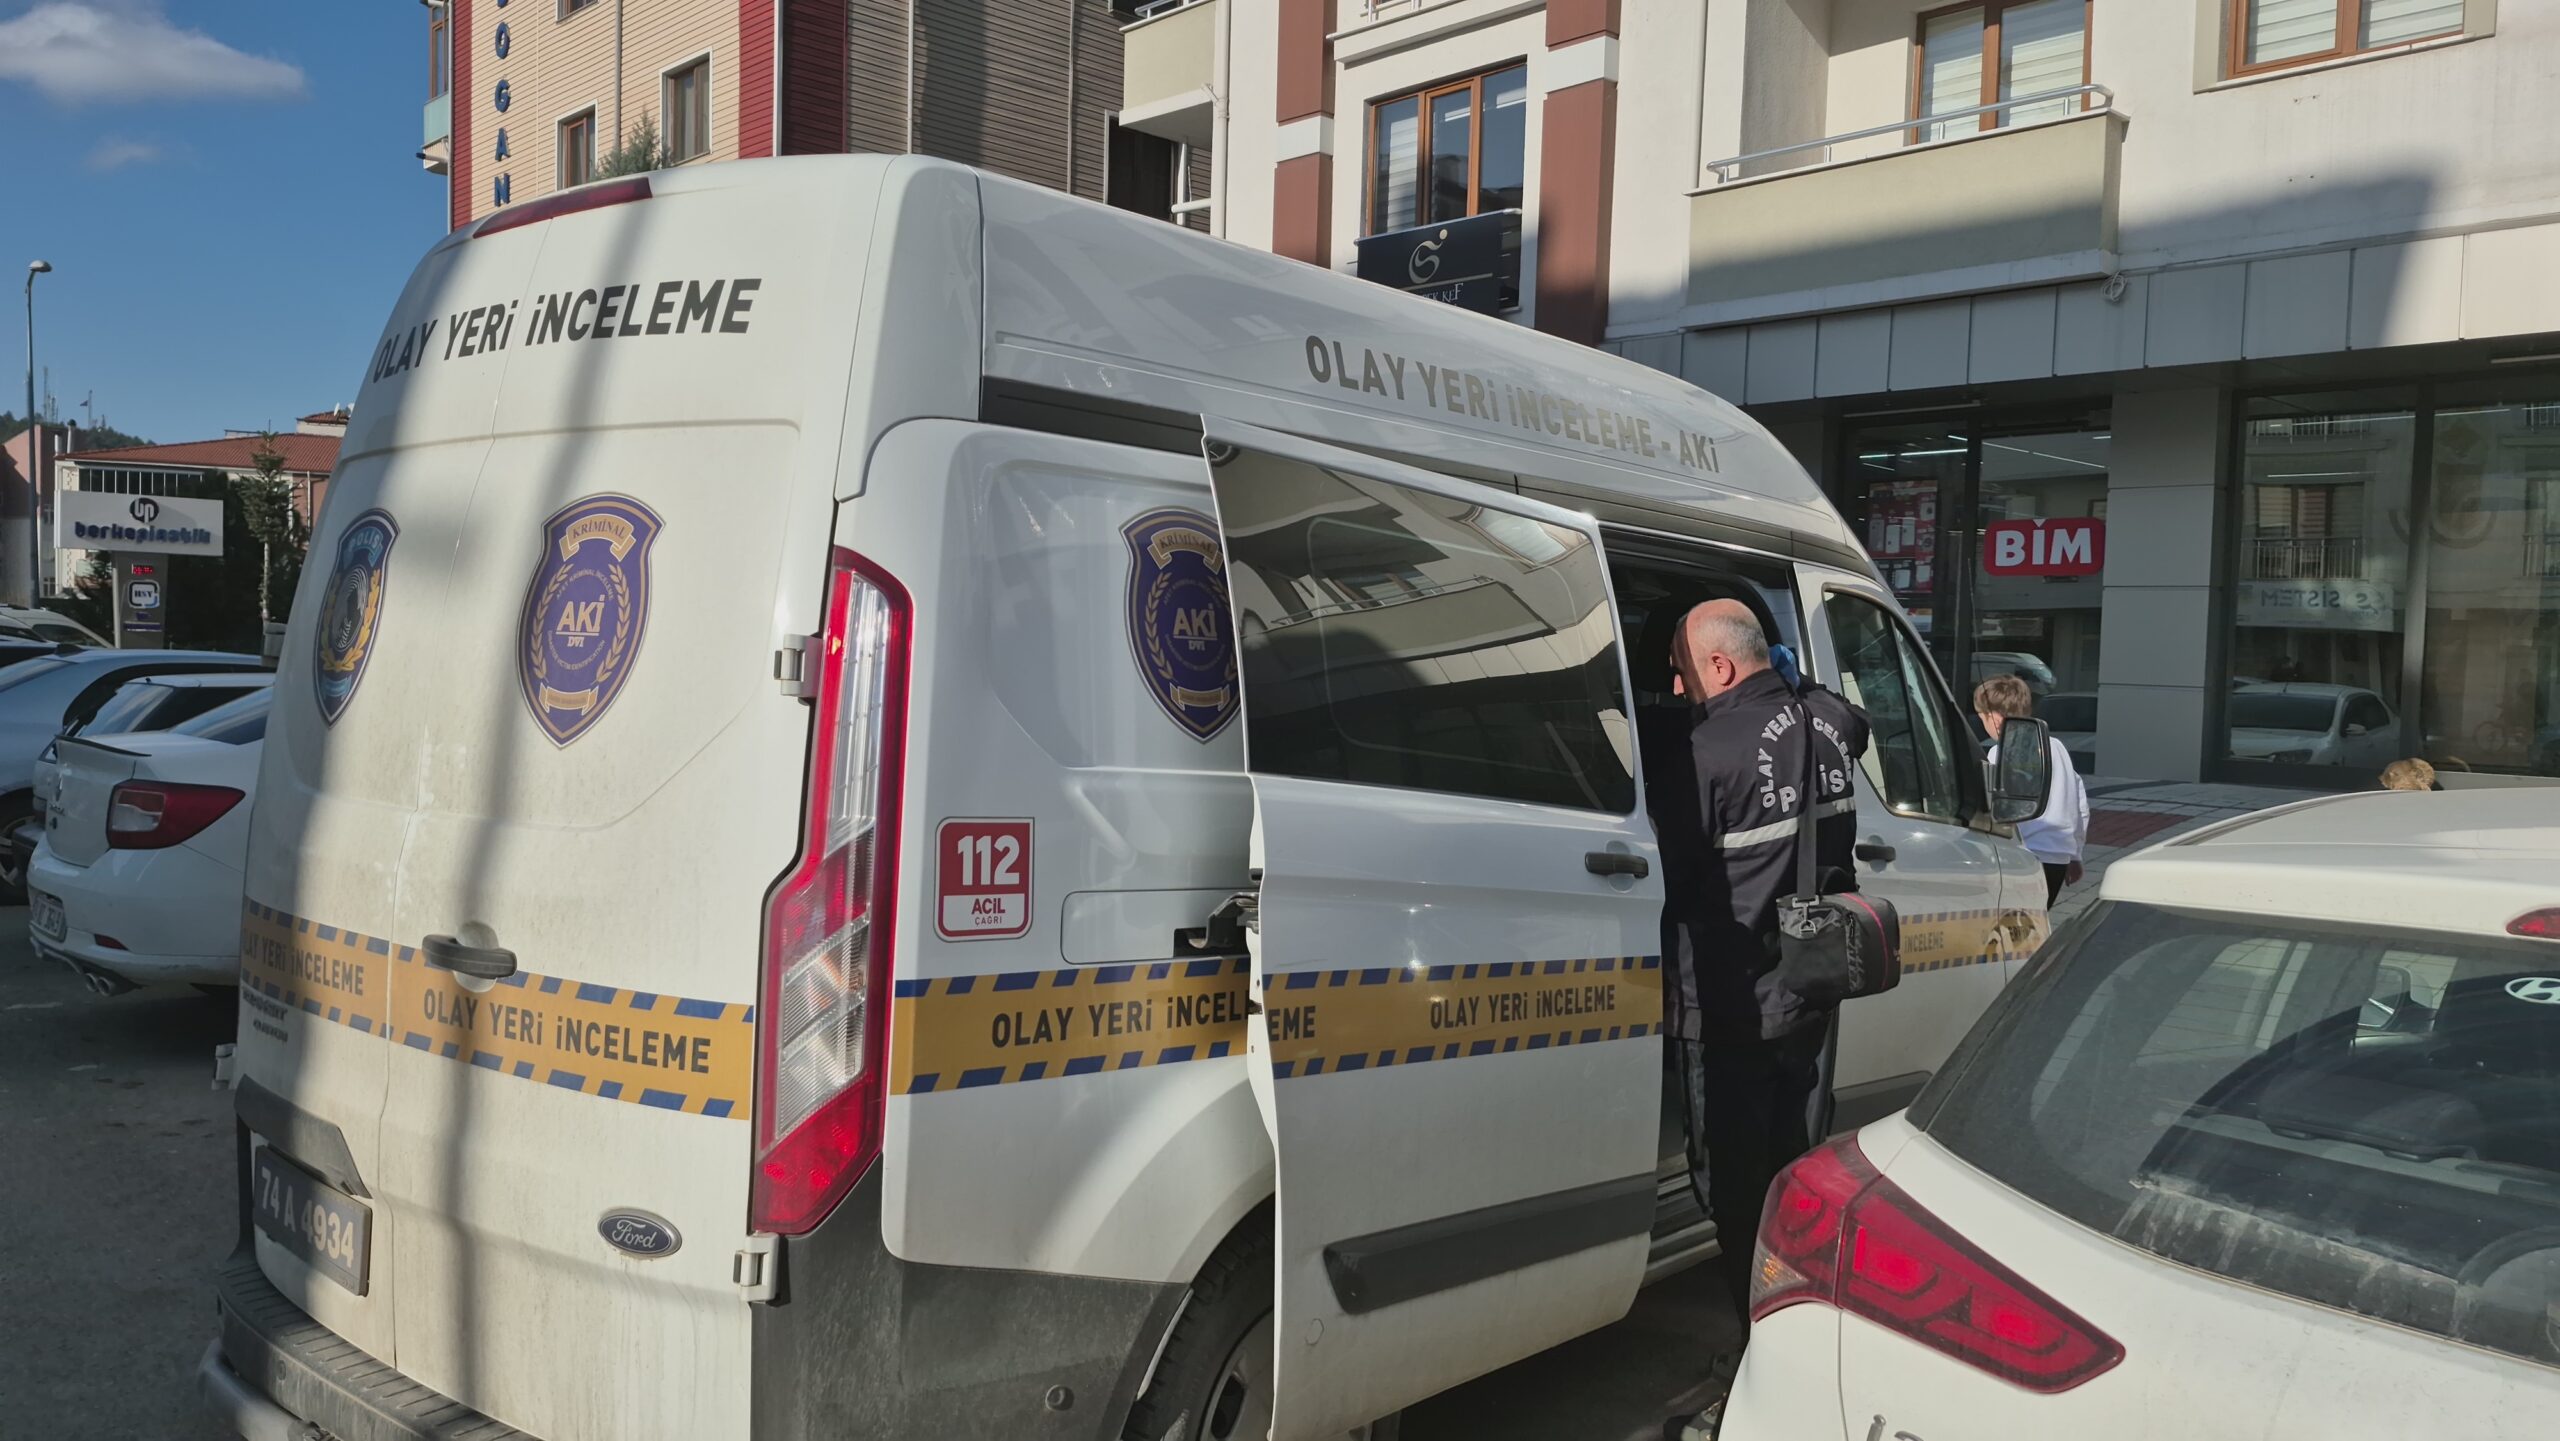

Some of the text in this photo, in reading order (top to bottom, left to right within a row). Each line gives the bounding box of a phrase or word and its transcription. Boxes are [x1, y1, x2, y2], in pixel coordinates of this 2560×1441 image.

[373, 319, 438, 384] OLAY
[1305, 335, 1406, 400] OLAY
[1995, 518, 2092, 567] BİM
[1757, 747, 1776, 809] OLAY
[957, 834, 1020, 886] 112
[424, 988, 478, 1031] OLAY
[991, 1006, 1074, 1048] OLAY
[1430, 996, 1480, 1029] OLAY
[261, 1165, 355, 1269] 74 A 4934
[611, 1219, 658, 1248] Ford
